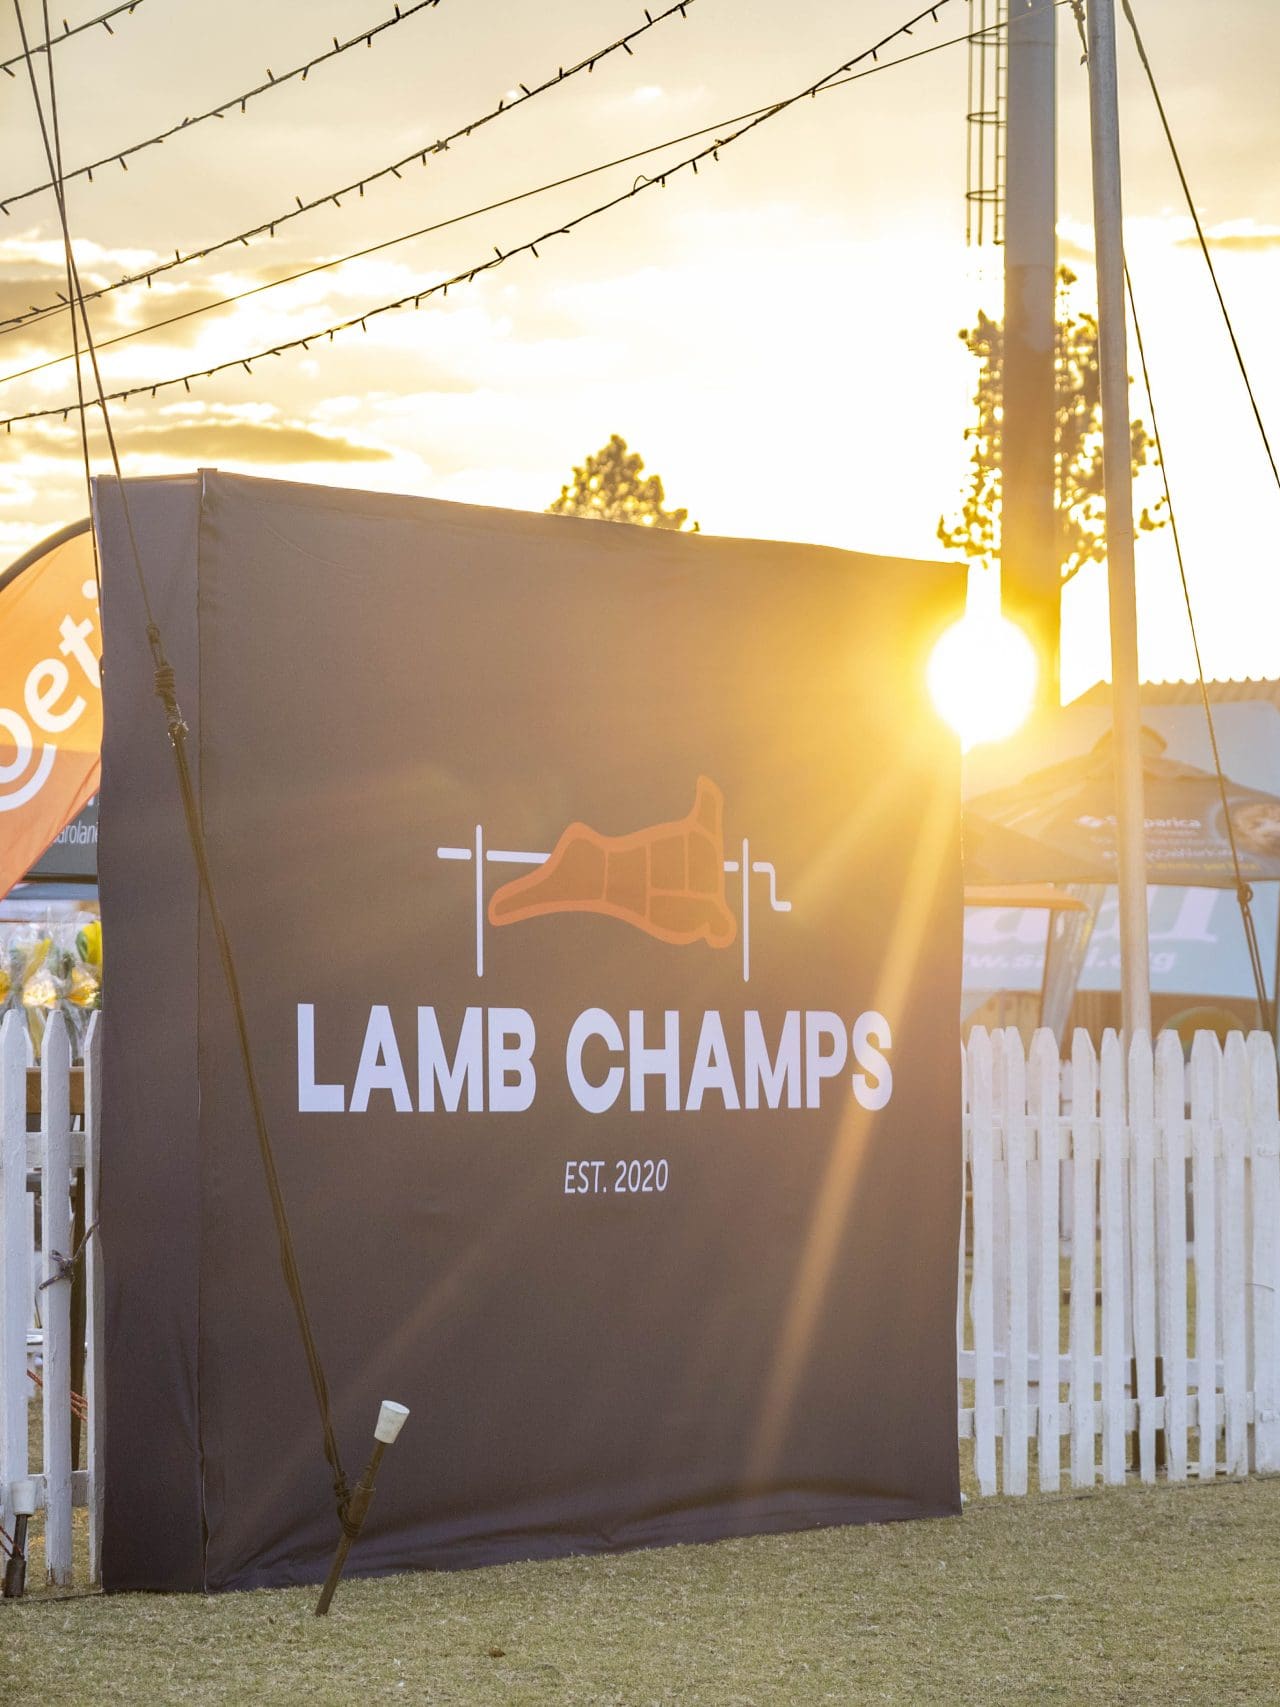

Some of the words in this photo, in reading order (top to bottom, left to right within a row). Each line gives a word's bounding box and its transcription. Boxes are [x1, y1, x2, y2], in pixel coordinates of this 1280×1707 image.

[298, 1003, 537, 1112] LAMB
[566, 1007, 893, 1113] CHAMPS
[564, 1160, 608, 1194] EST.
[614, 1158, 669, 1194] 2020
